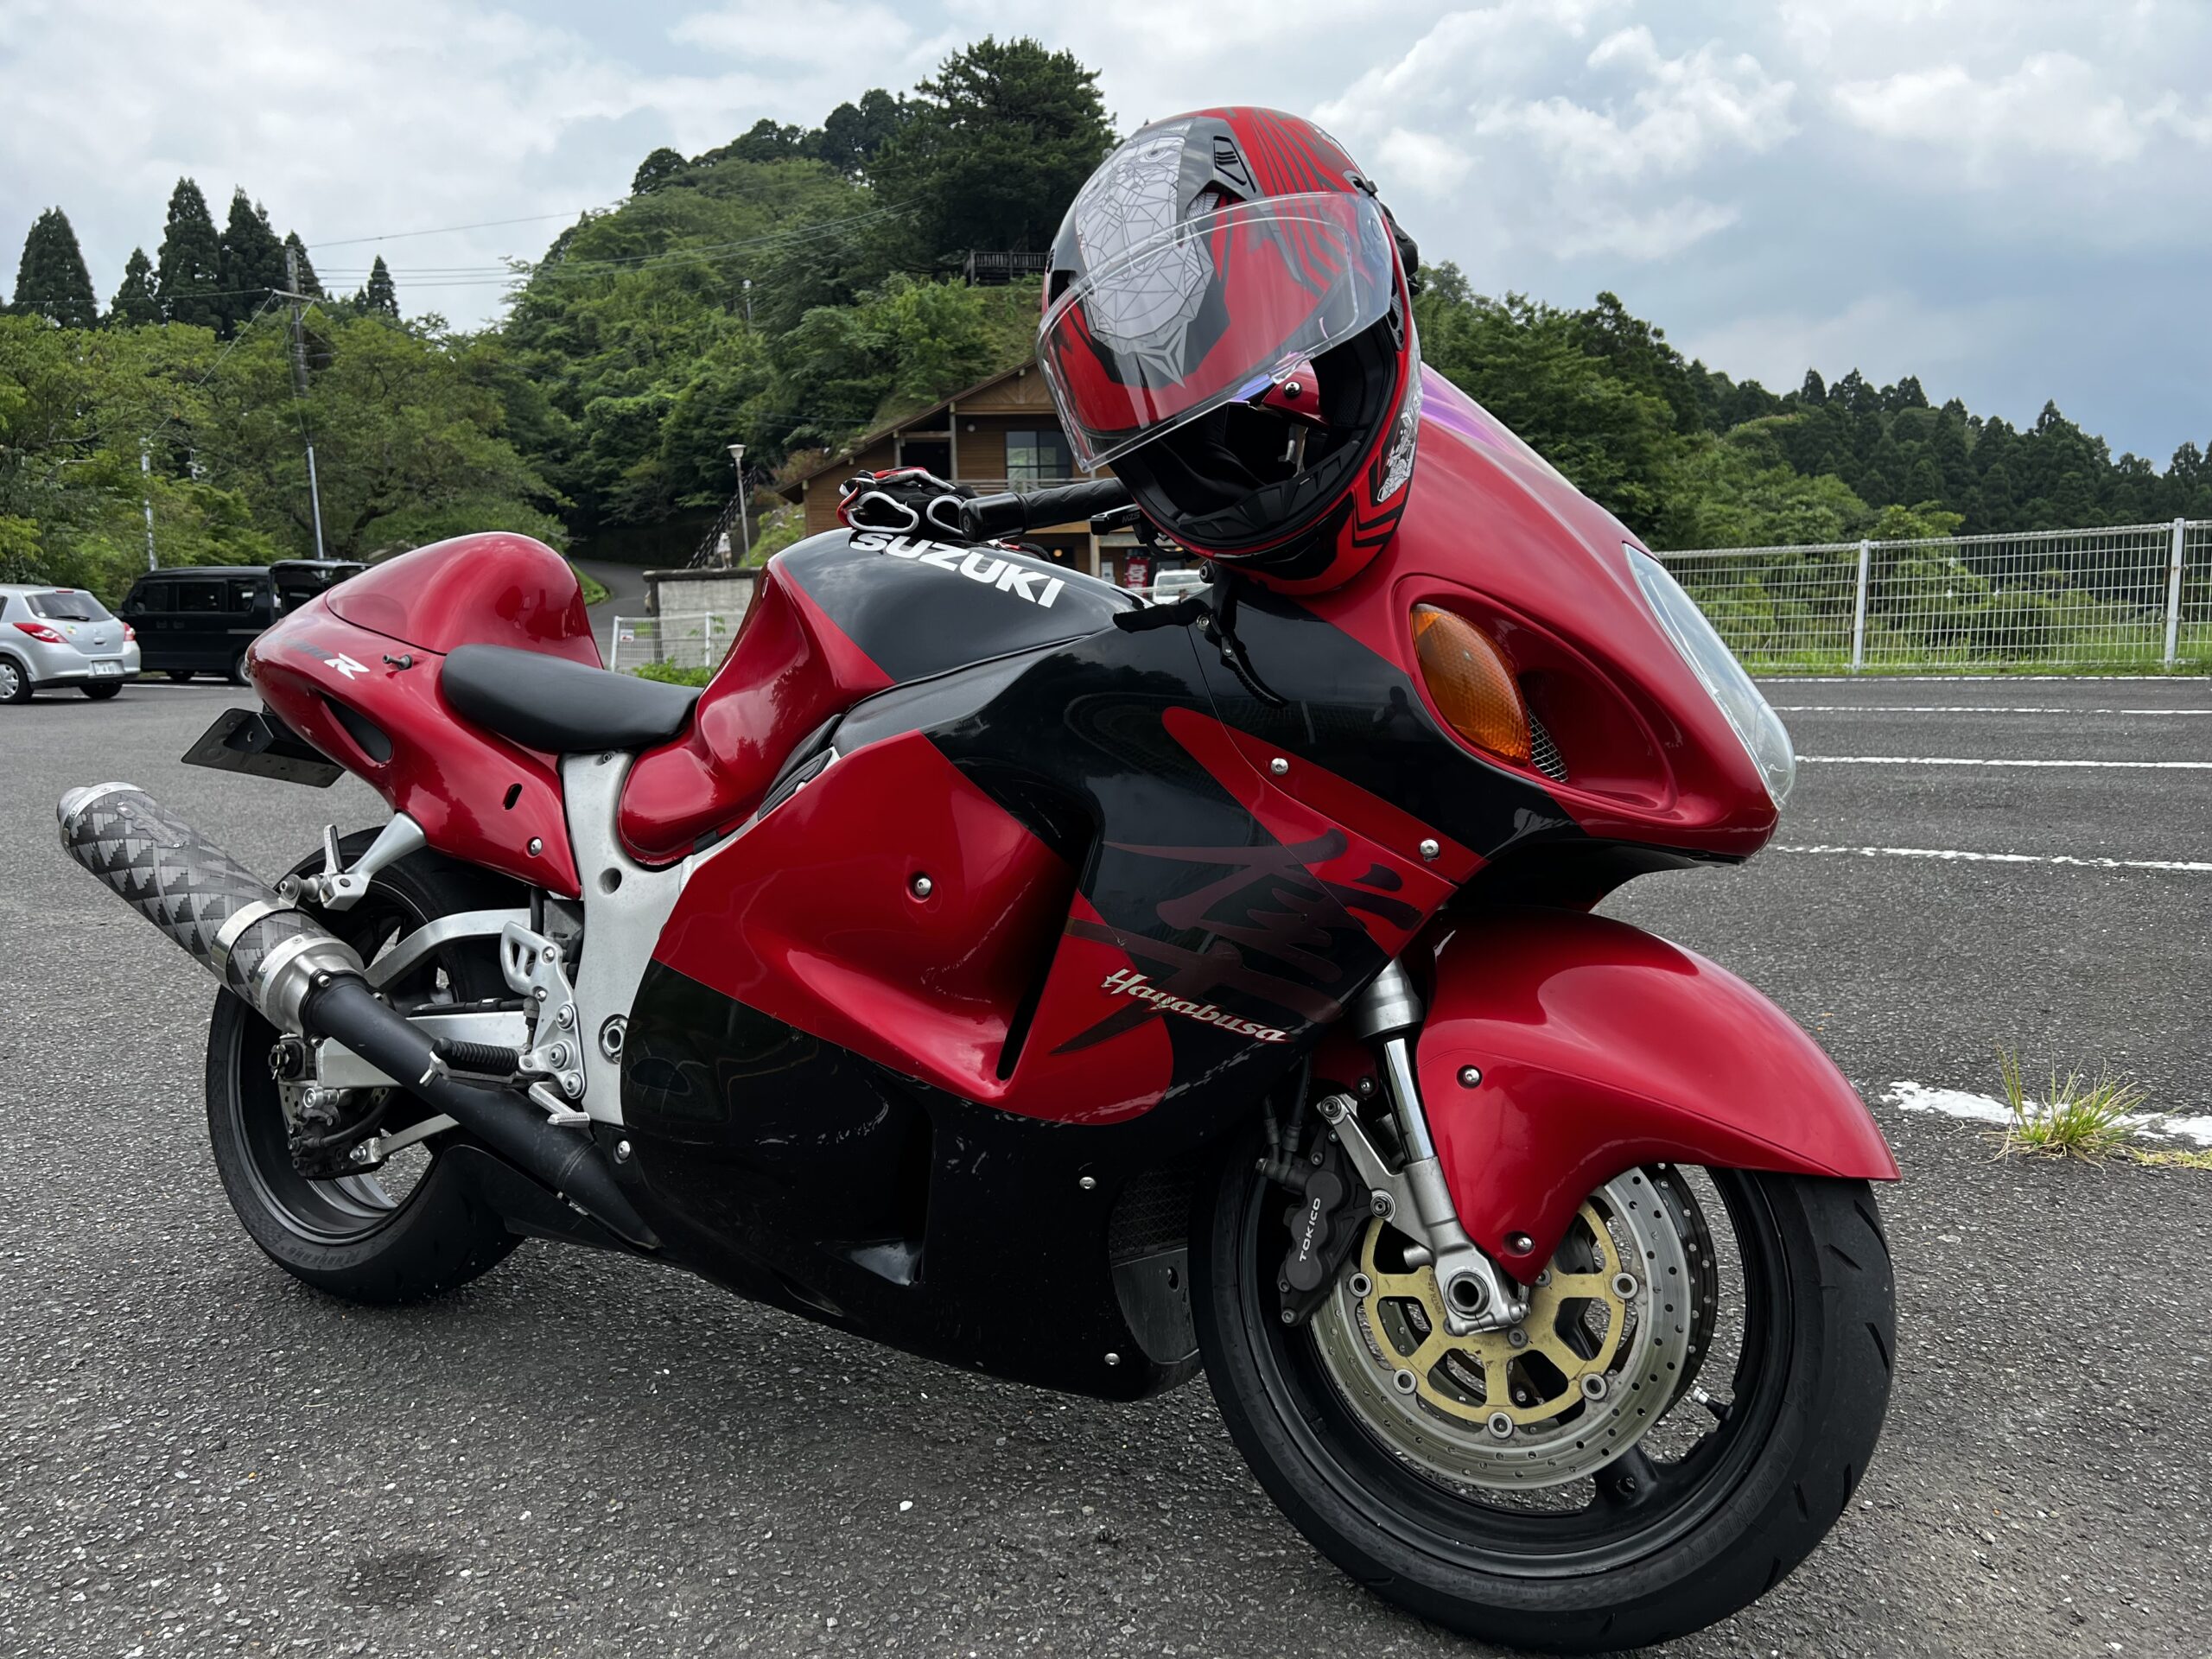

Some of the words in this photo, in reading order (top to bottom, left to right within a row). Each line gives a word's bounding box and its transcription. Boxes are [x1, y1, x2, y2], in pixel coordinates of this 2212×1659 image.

[850, 532, 1065, 608] SUZUKI
[324, 652, 370, 680] R
[1101, 969, 1288, 1041] Hayabusa
[1299, 1198, 1321, 1262] TOKICO
